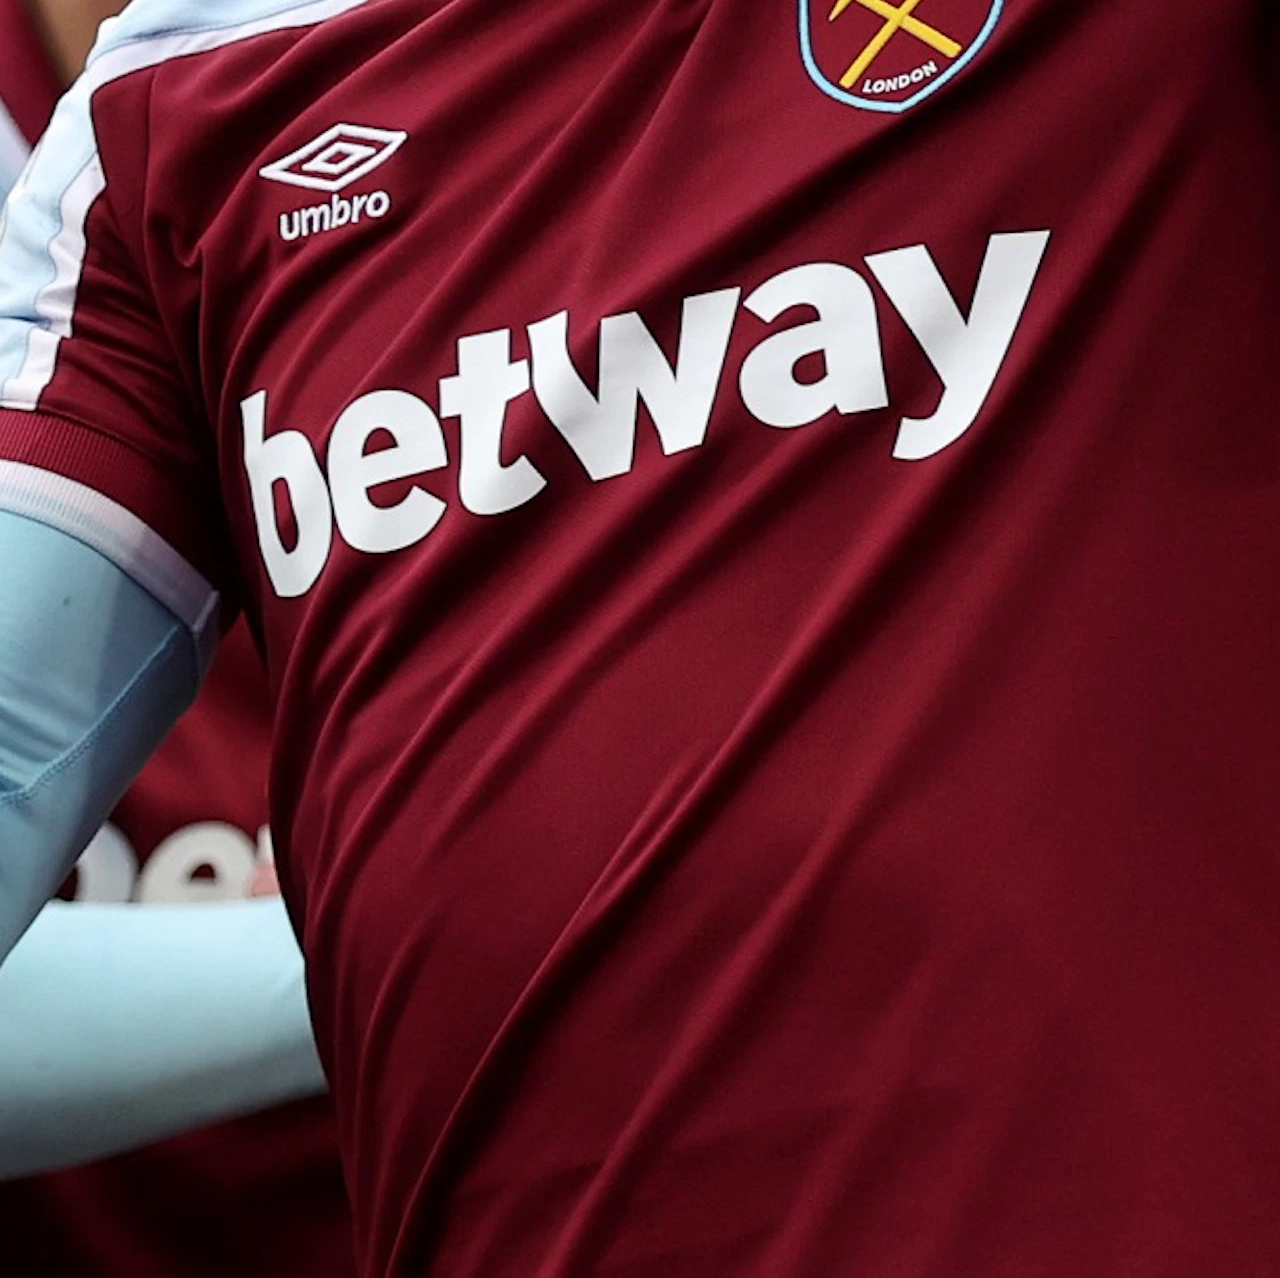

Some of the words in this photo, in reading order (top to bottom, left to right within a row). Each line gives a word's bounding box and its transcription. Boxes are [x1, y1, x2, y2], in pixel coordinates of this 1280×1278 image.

[862, 60, 938, 95] LONDON
[279, 190, 391, 241] umbro
[240, 229, 1052, 599] betway
